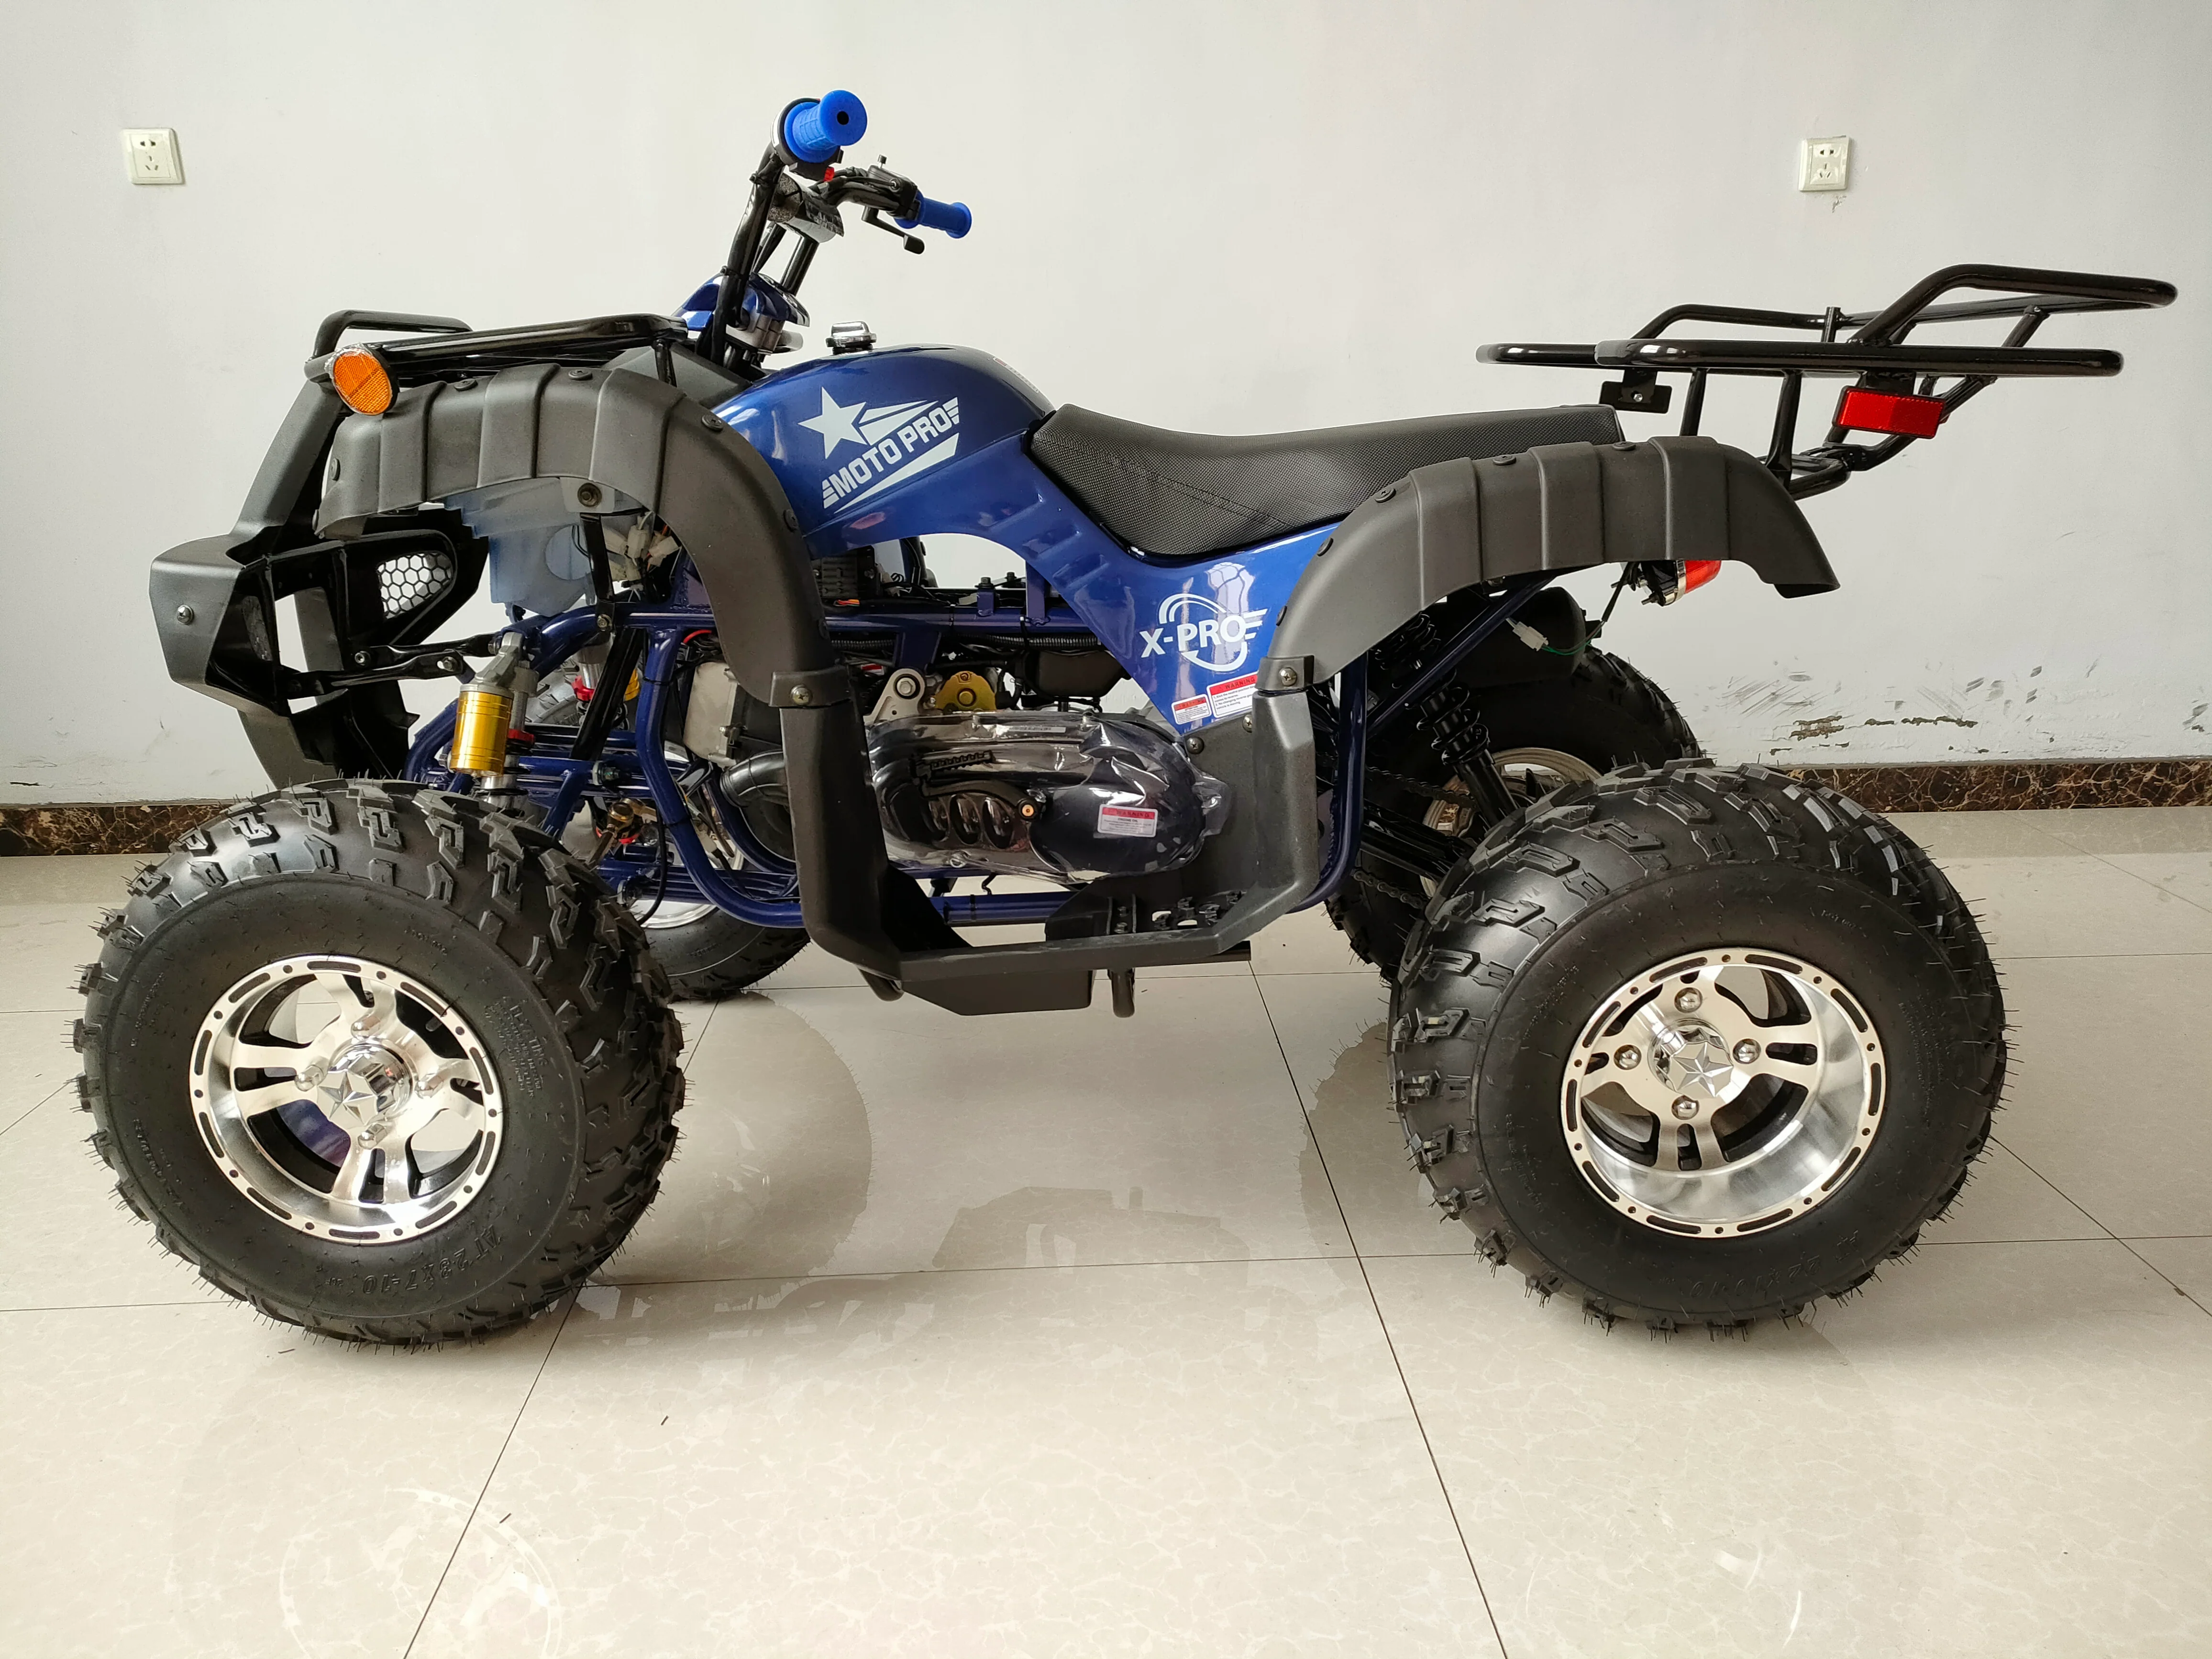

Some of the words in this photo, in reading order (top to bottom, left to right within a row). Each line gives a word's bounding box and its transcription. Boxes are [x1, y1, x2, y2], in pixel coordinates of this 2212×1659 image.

[828, 438, 902, 498] MOTO
[897, 407, 952, 453] PRO
[1139, 615, 1247, 658] X-PRO
[1225, 677, 1255, 689] WARNING
